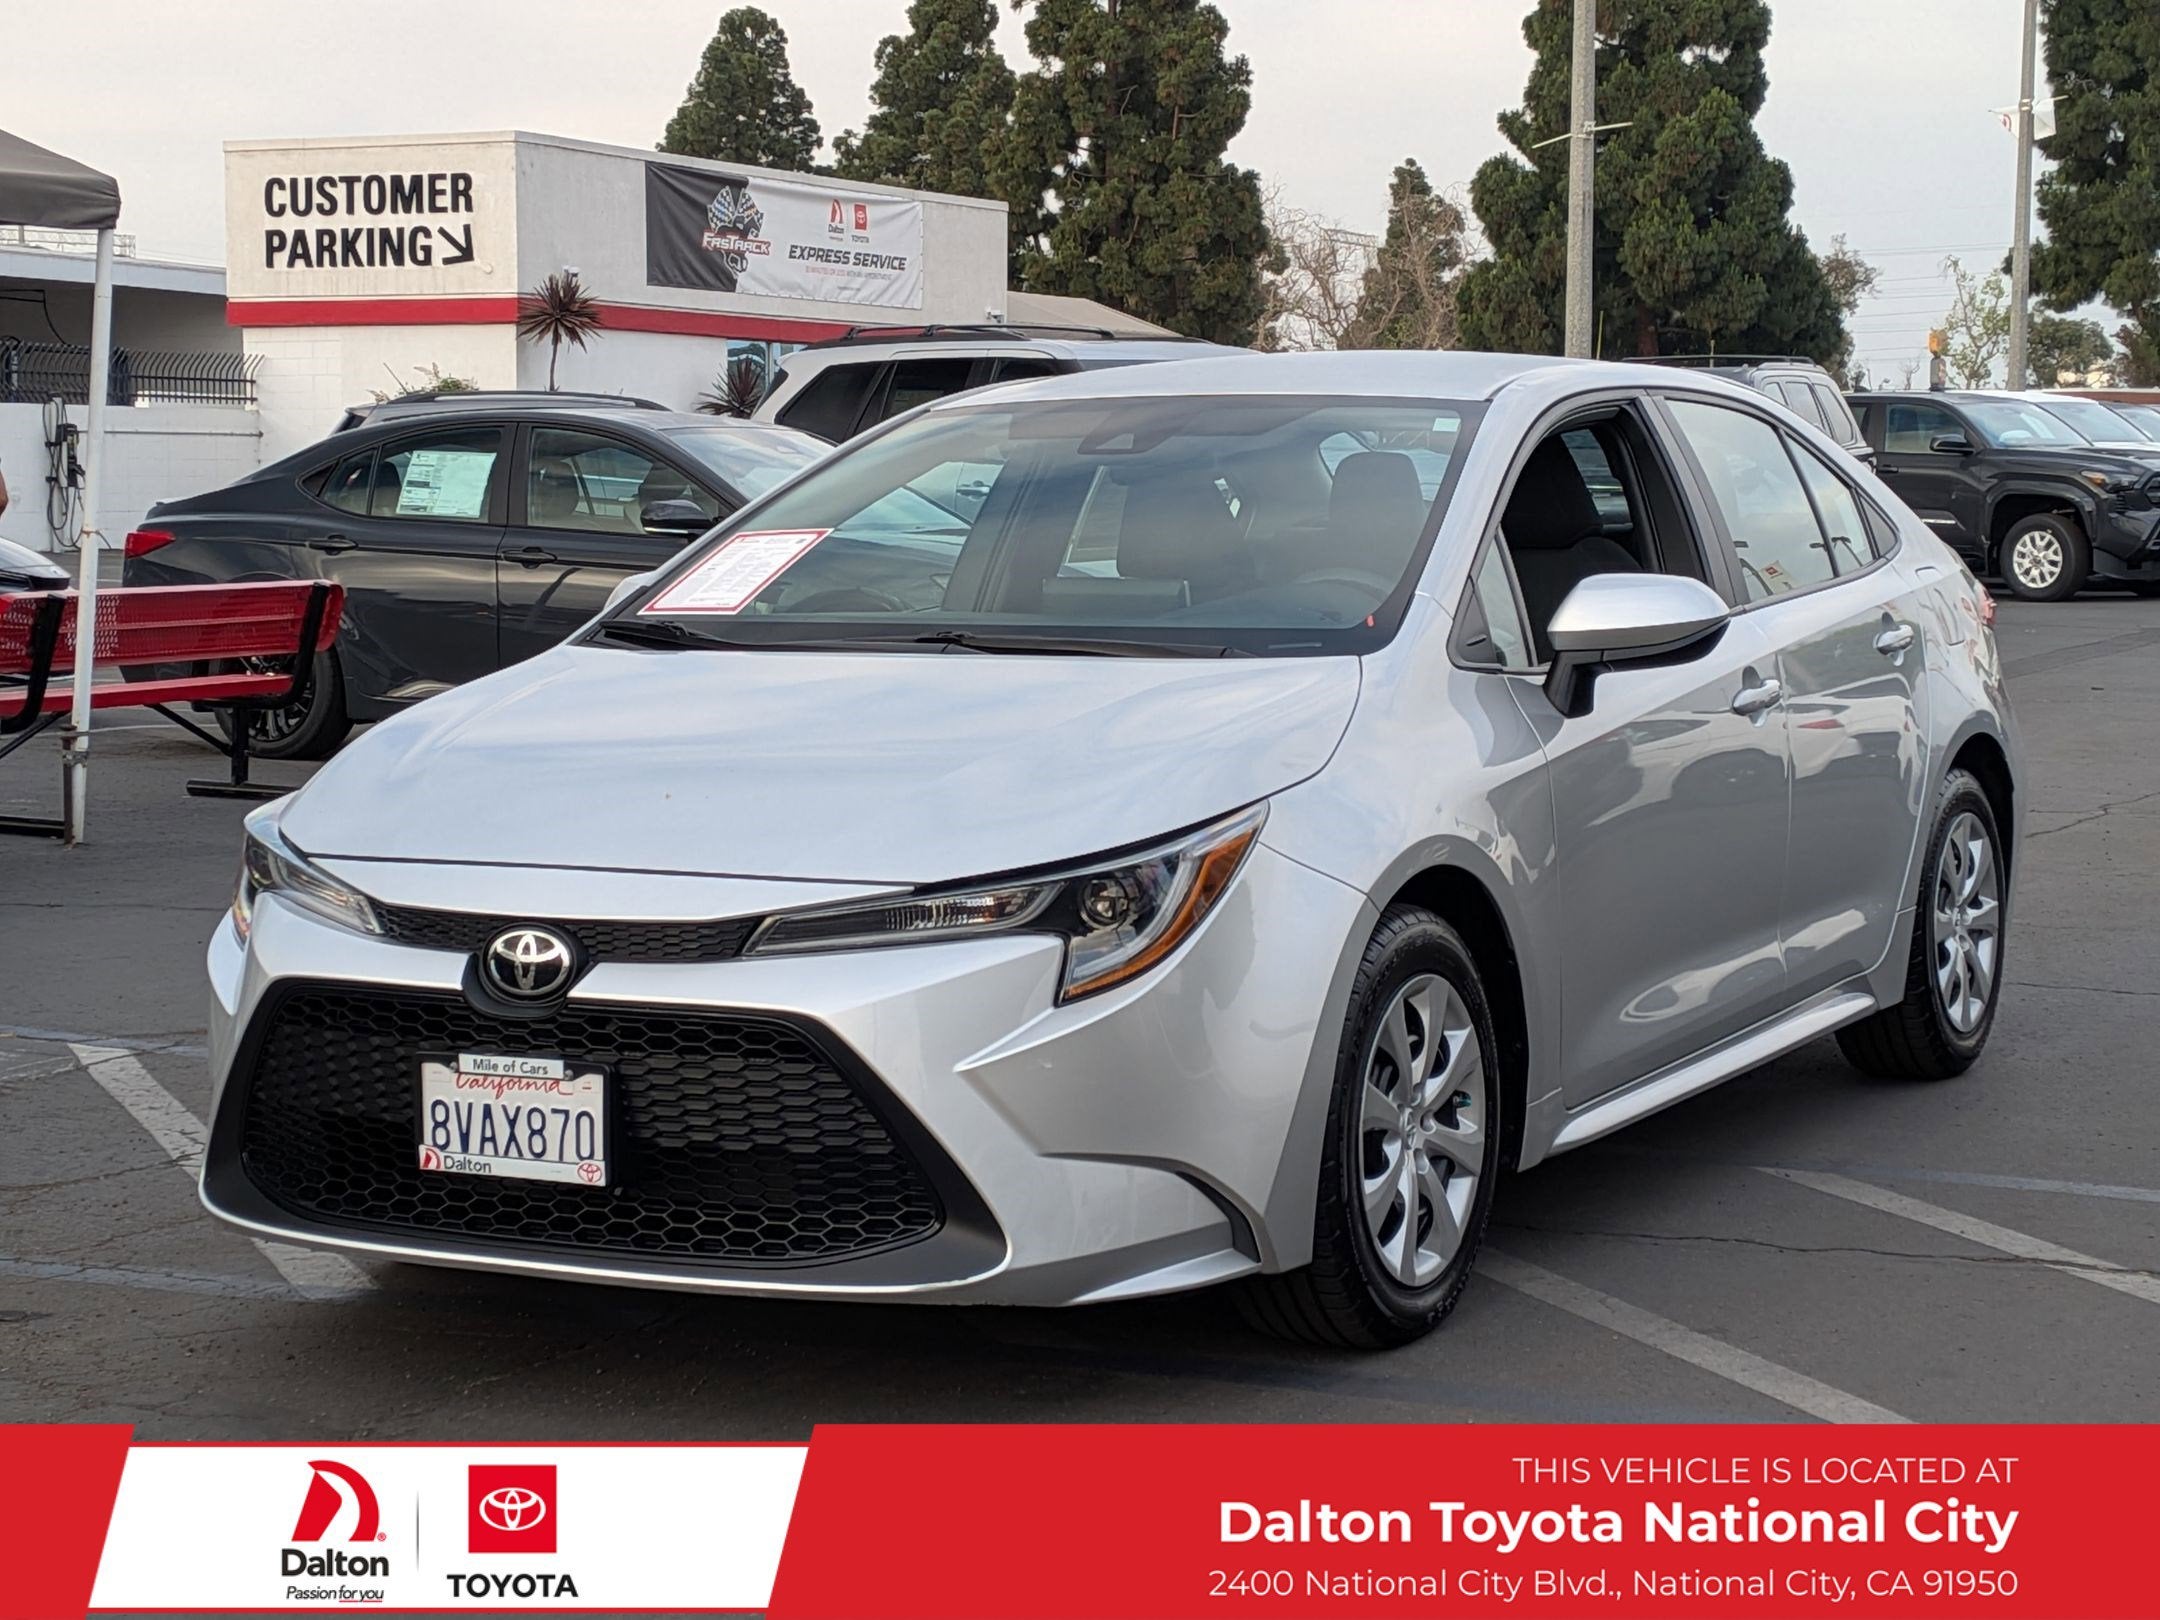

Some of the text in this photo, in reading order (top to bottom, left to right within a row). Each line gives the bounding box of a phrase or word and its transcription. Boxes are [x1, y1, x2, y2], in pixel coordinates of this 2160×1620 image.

[264, 173, 473, 217] CUSTOMER
[265, 225, 433, 268] PARKING
[788, 244, 907, 271] EXPRESS SERVICE
[473, 1059, 549, 1075] Mile of Cars
[431, 1099, 595, 1162] 8VAX870
[443, 1155, 492, 1173] Dalton
